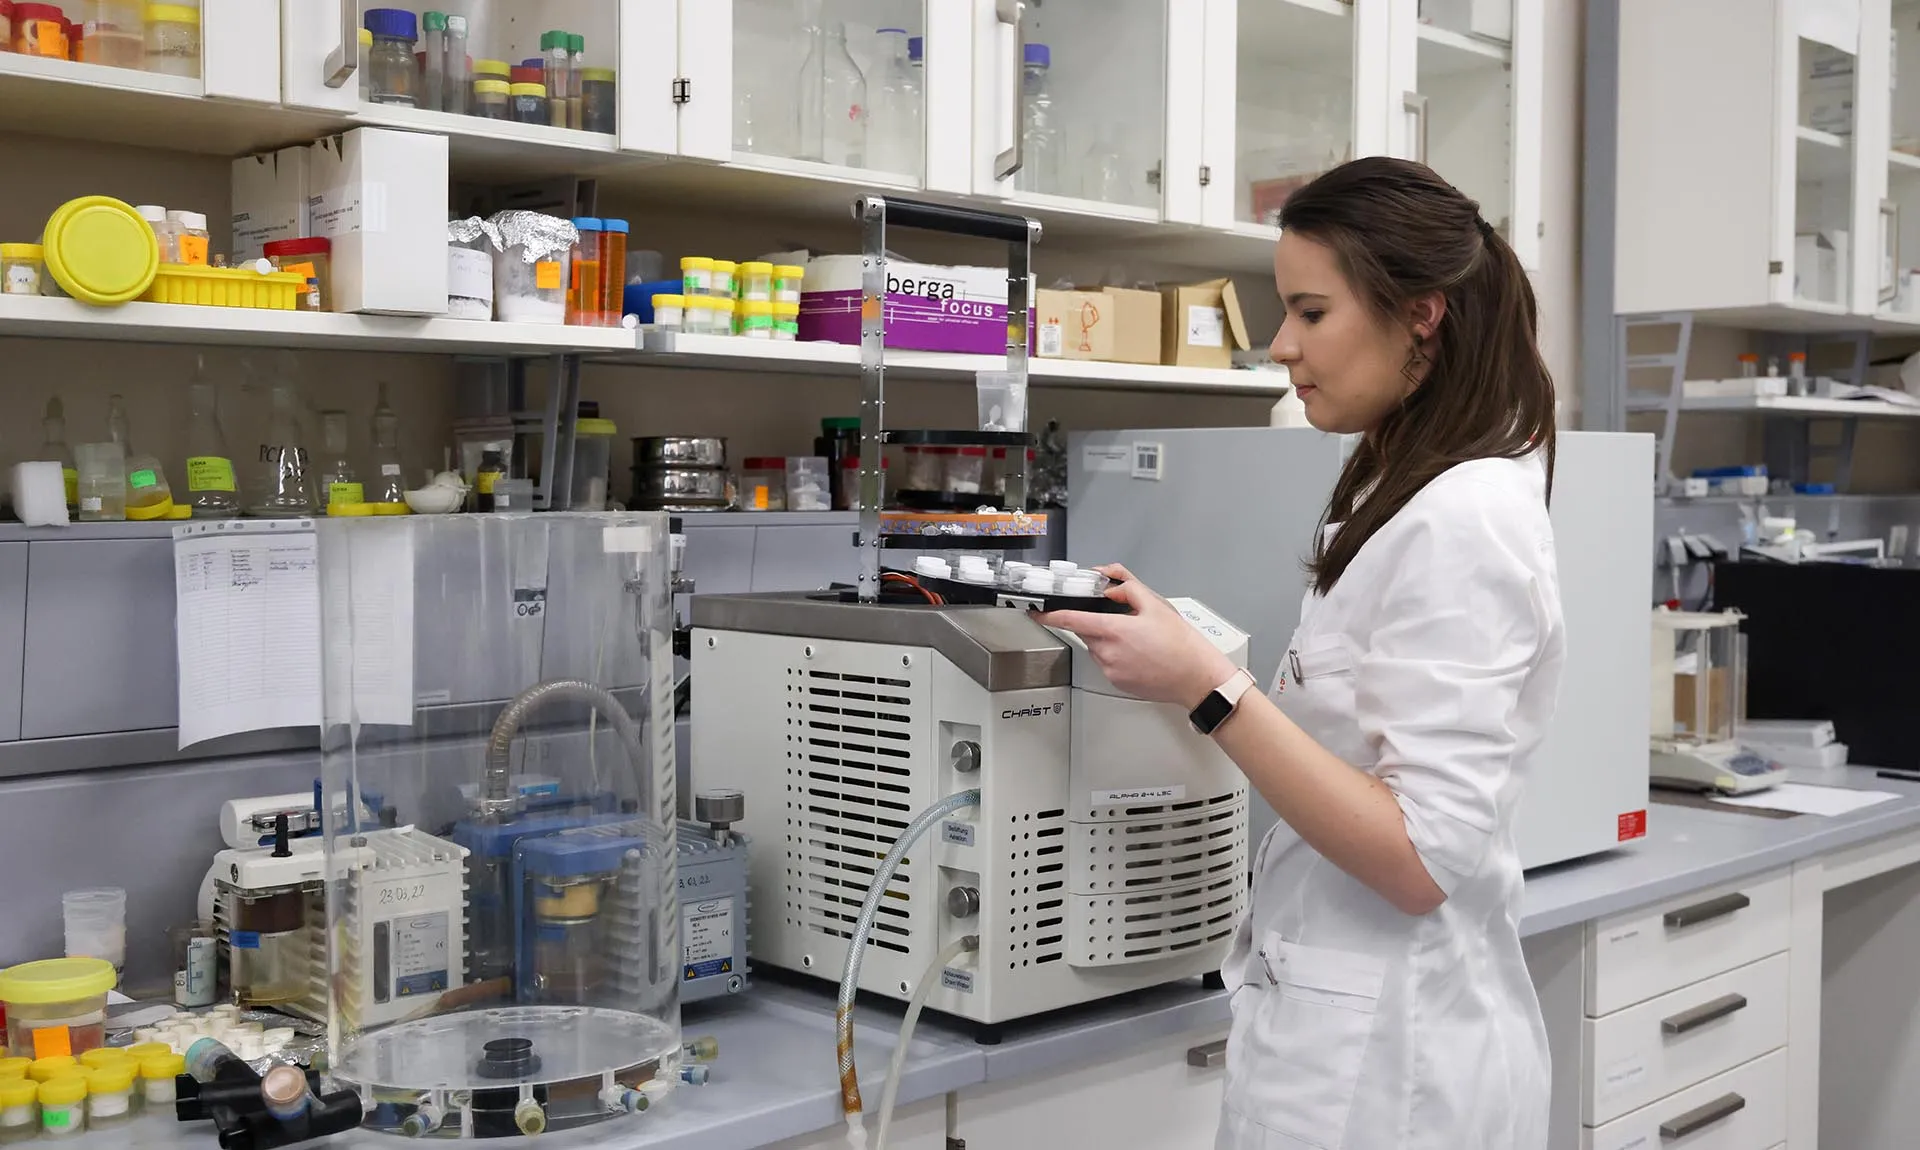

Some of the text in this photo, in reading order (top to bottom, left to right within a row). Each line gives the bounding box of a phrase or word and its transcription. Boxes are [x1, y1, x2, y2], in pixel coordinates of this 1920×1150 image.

[886, 273, 954, 301] berga
[940, 298, 994, 317] focus
[1001, 704, 1052, 719] CHRIST
[1109, 792, 1139, 800] ALPHA
